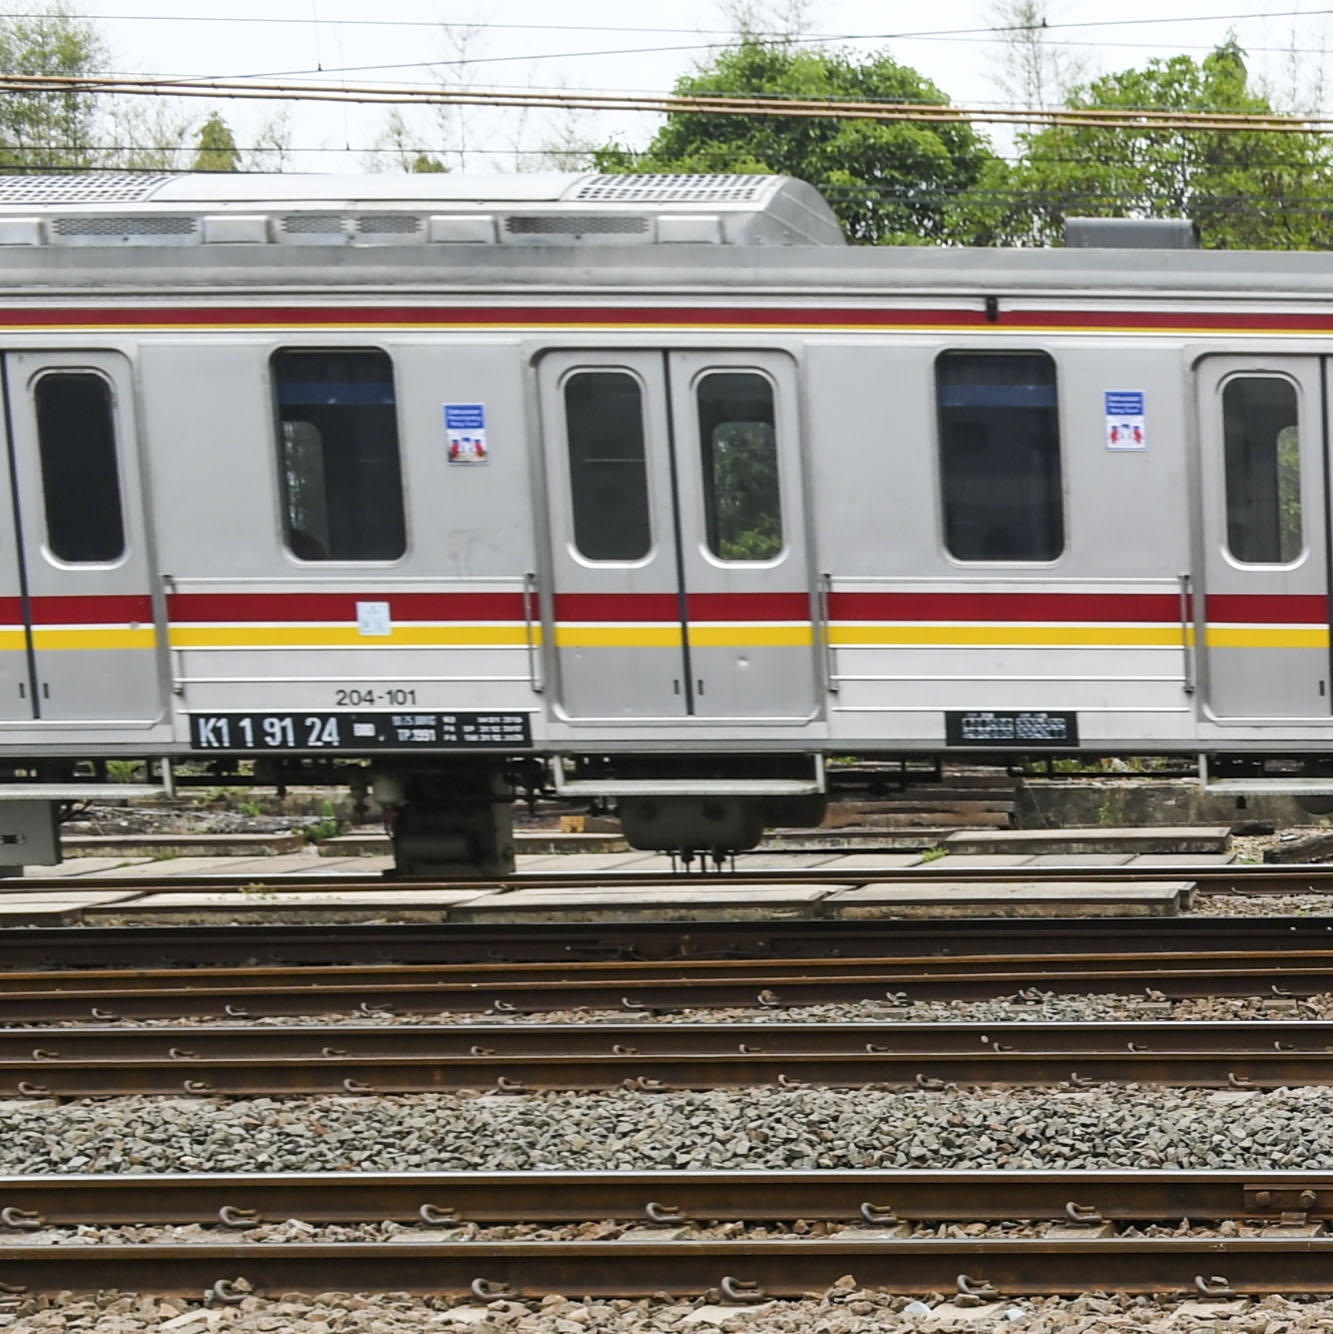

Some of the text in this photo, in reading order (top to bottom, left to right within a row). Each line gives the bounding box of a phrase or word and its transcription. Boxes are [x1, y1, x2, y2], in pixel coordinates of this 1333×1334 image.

[336, 689, 418, 706] 204-101
[198, 717, 231, 747] K1
[239, 717, 255, 747] 1
[262, 717, 296, 747] 91
[304, 716, 341, 747] 24
